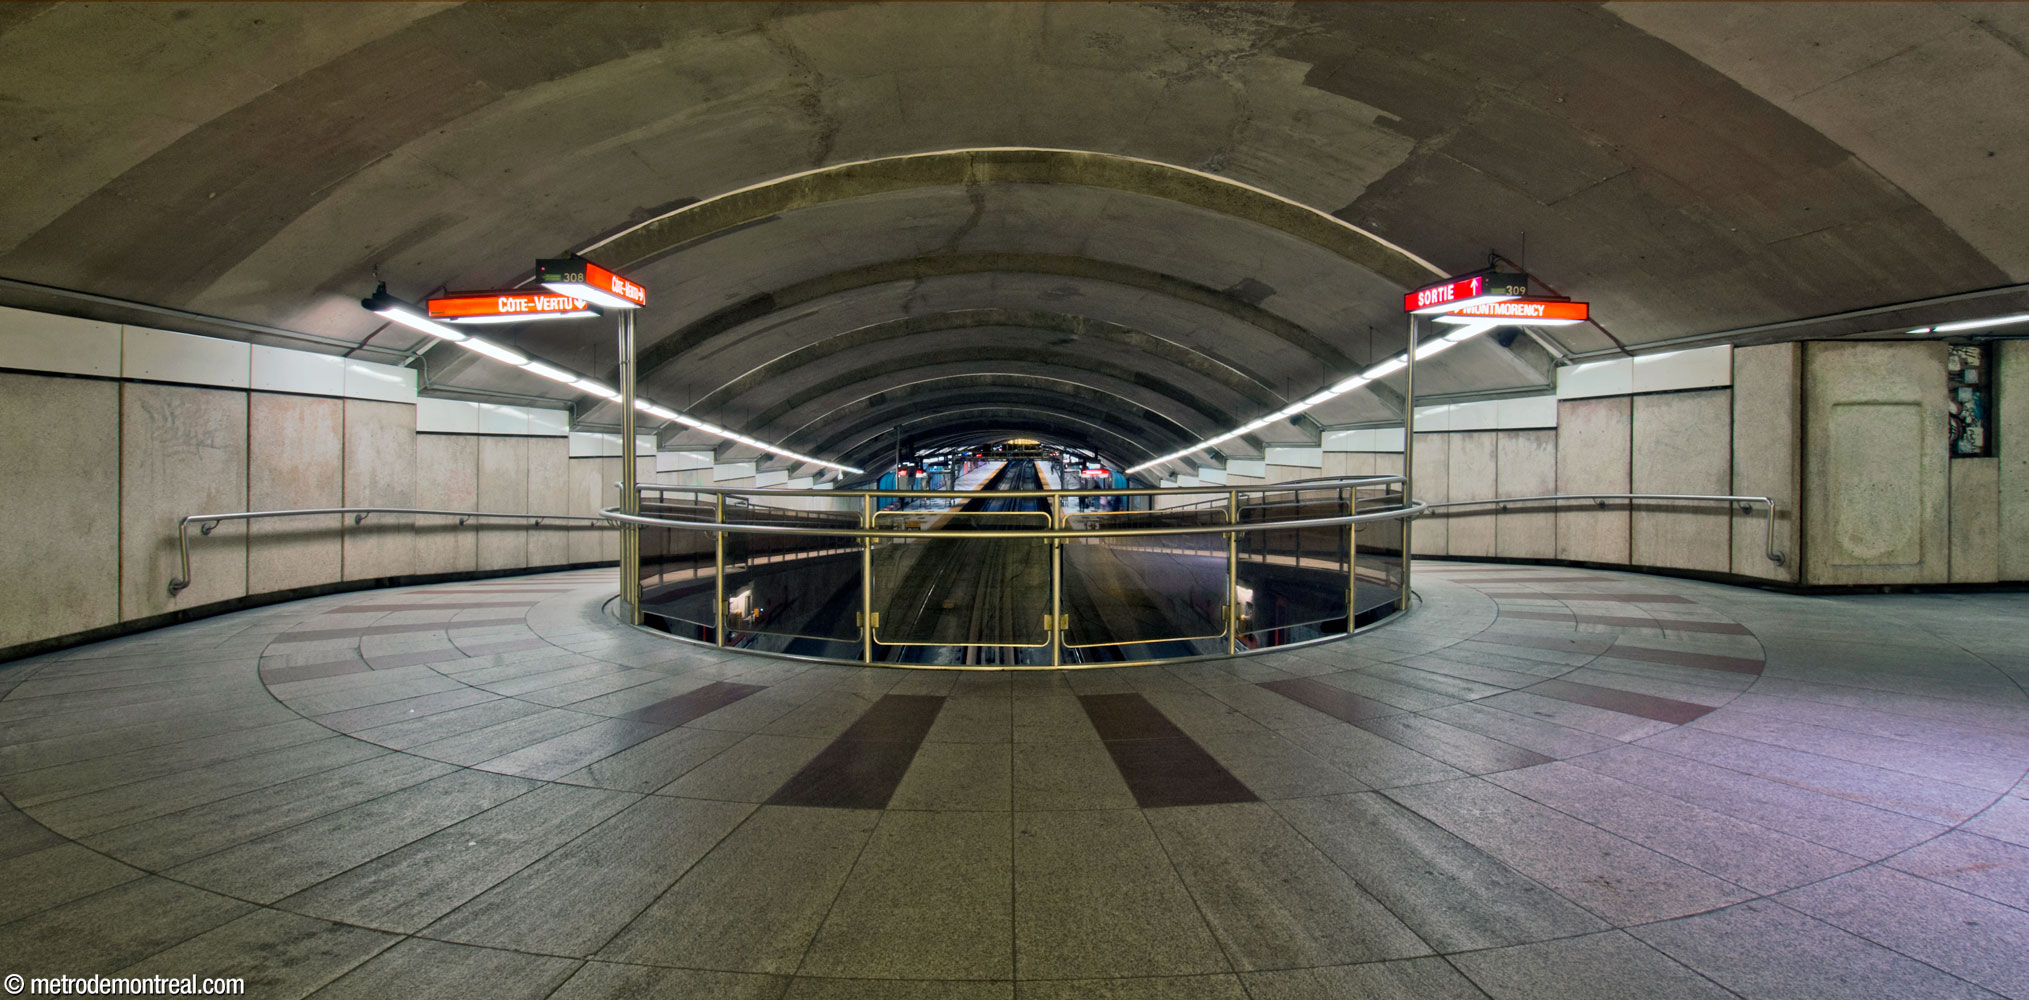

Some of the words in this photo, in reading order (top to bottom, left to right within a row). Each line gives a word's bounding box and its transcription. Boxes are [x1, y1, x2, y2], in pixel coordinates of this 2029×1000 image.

[563, 272, 584, 283] 308
[1418, 284, 1454, 306] SORTIE
[1506, 285, 1526, 296] 309
